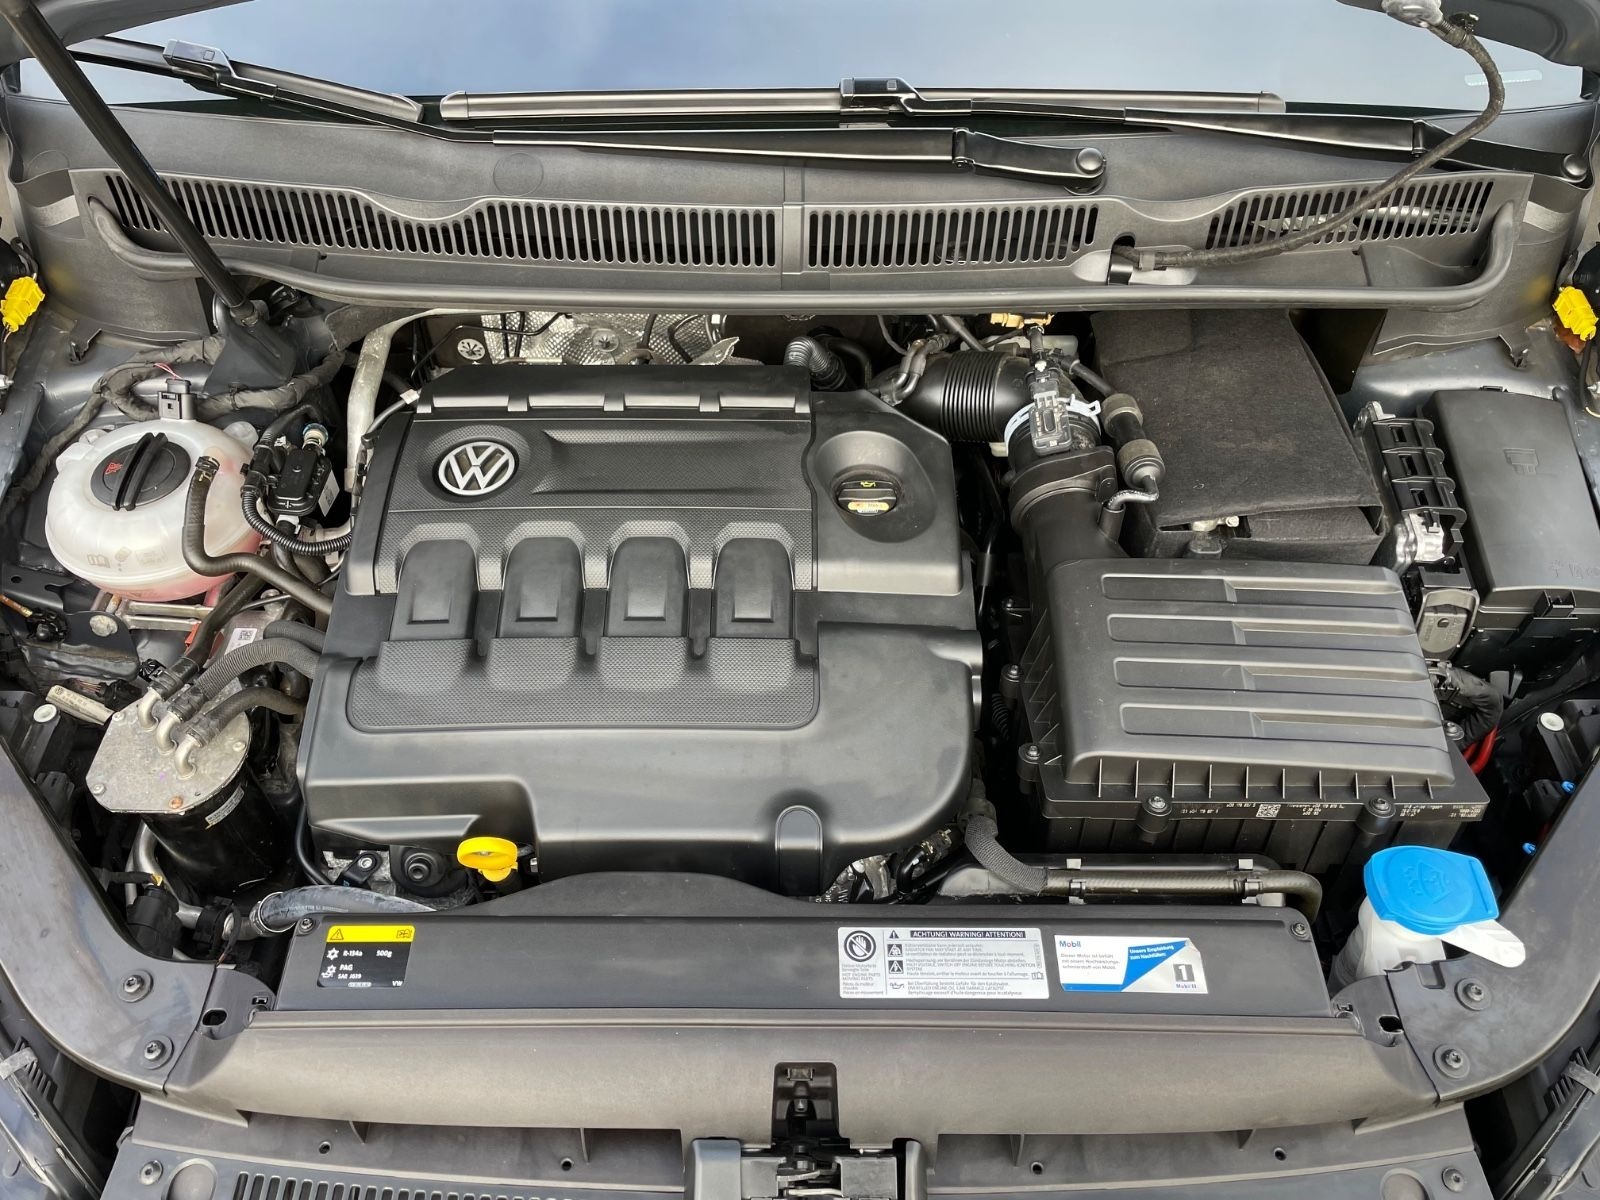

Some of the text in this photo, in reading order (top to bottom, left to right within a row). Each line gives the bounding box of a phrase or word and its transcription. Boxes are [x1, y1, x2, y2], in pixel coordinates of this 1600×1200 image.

[438, 441, 515, 496] VW
[1059, 940, 1081, 948] Mobil
[376, 949, 393, 958] 500g
